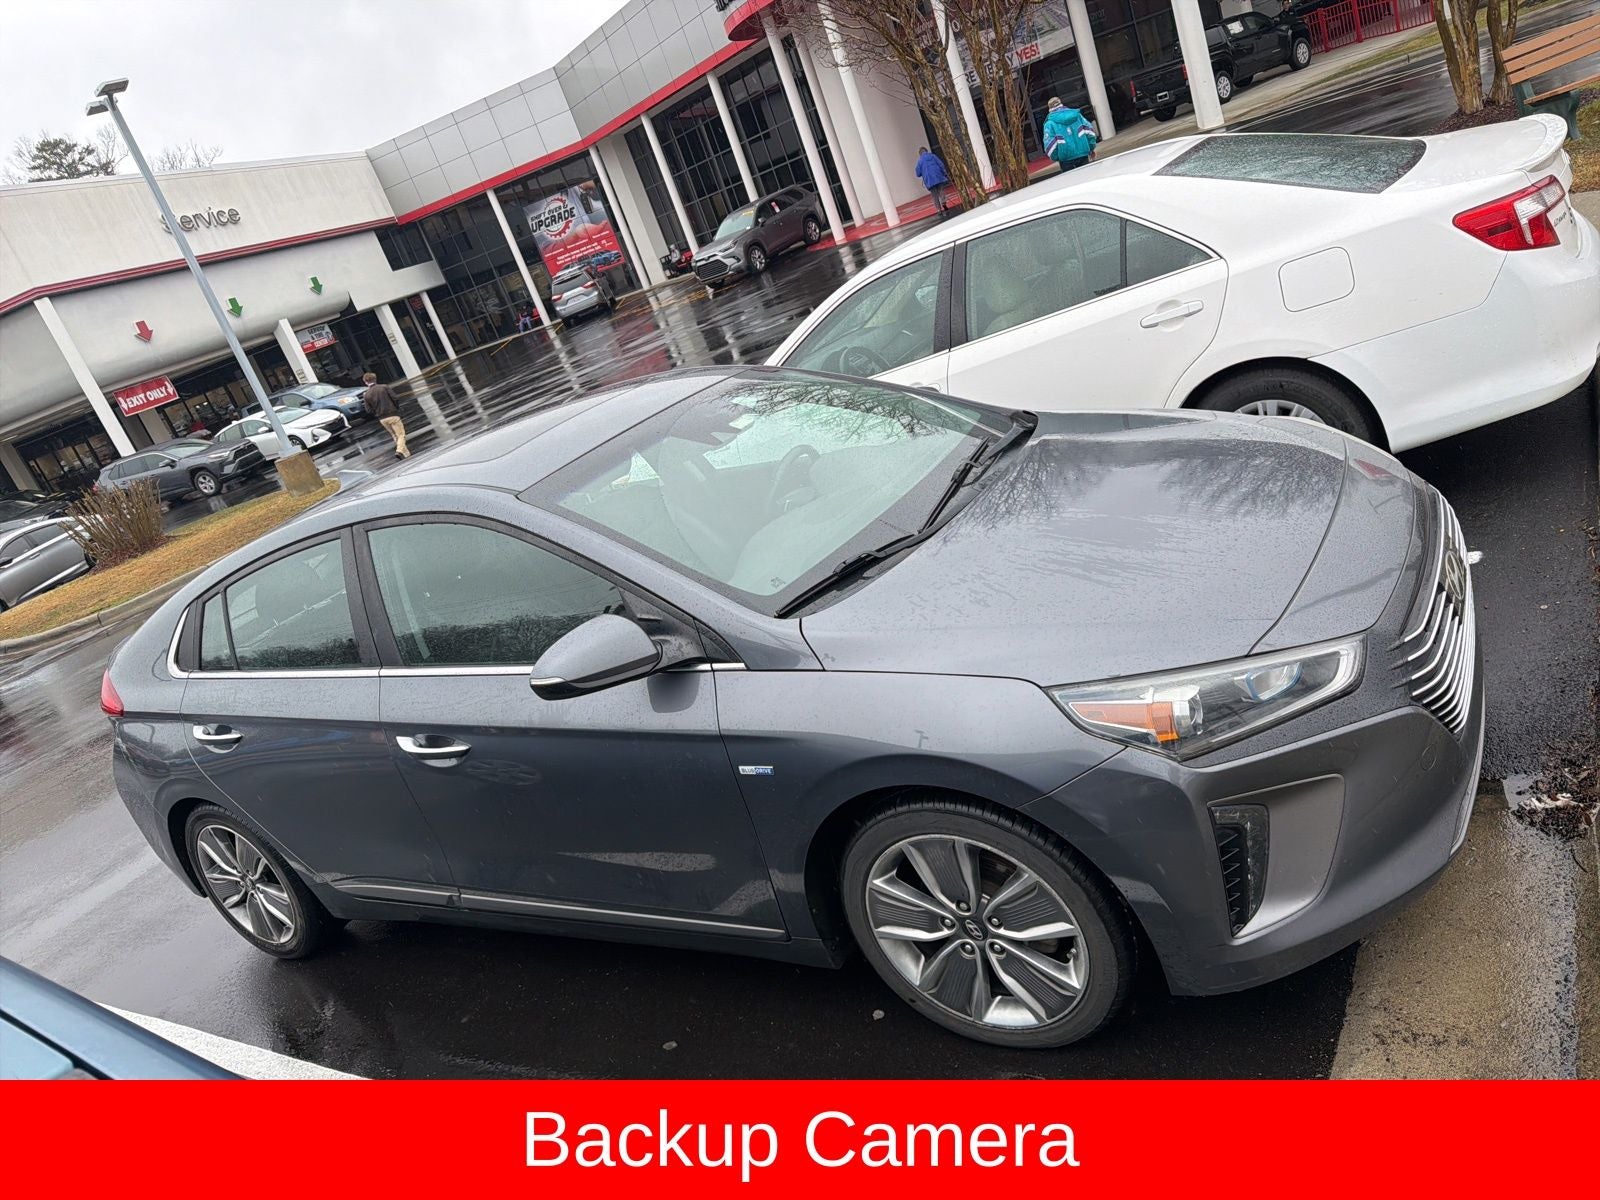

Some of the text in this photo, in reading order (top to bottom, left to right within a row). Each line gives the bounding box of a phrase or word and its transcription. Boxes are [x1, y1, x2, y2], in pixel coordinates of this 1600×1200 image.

[1015, 42, 1040, 61] YES!
[530, 212, 546, 221] SHIFT
[547, 205, 562, 215] OVER
[531, 206, 576, 233] UPGRADE
[126, 386, 168, 408] EXIT ONLY
